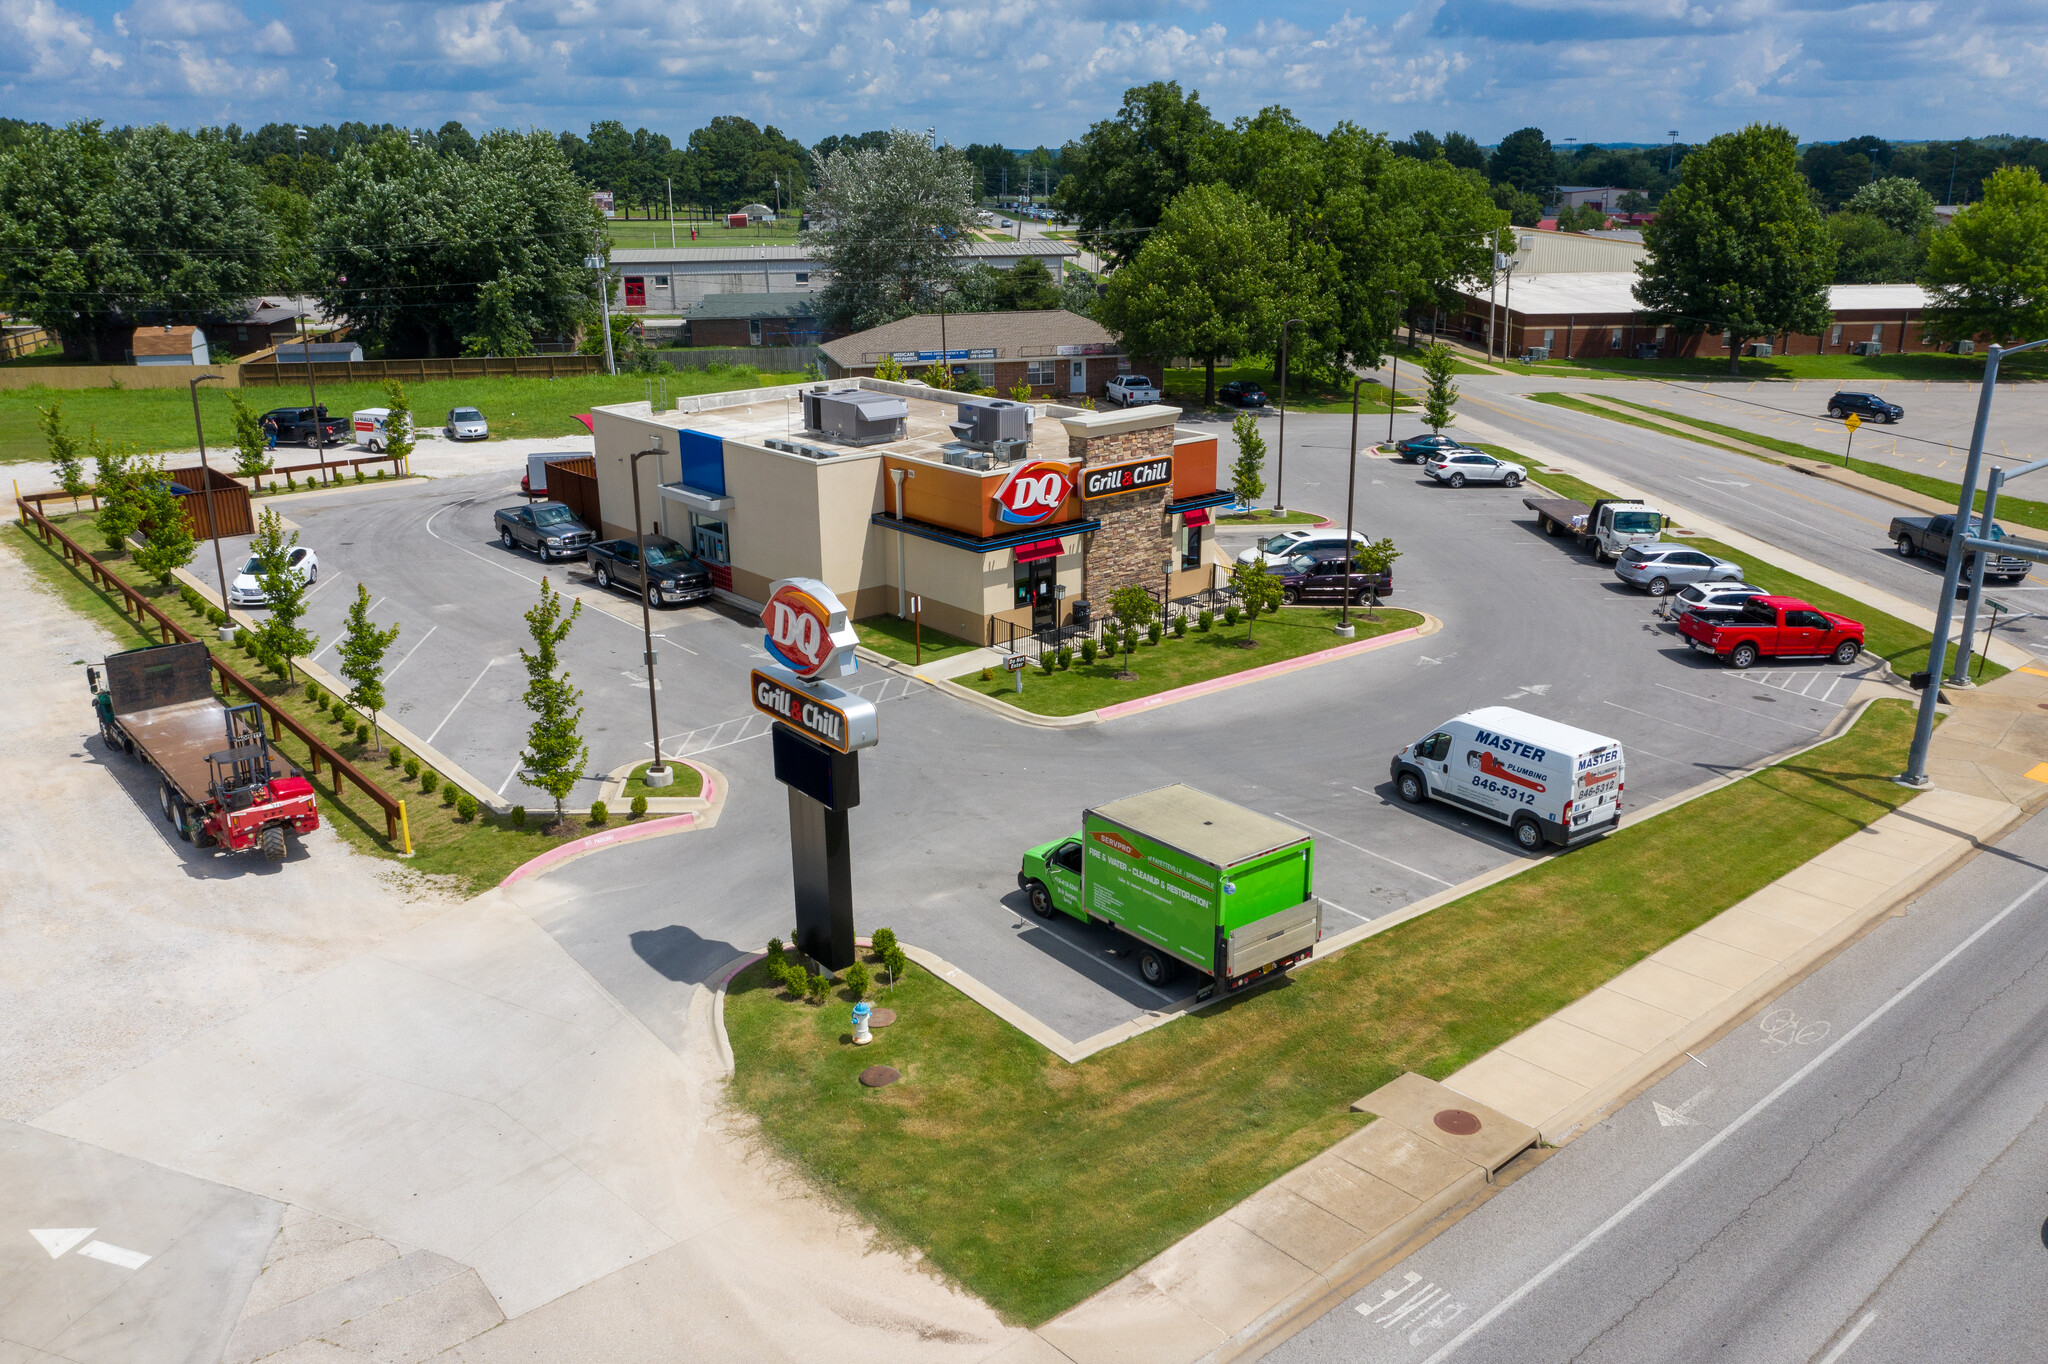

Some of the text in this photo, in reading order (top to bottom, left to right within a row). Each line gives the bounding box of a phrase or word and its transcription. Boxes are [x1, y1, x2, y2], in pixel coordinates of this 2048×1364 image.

[1012, 473, 1062, 510] DQ
[1089, 473, 1122, 493] Grill
[1133, 462, 1167, 484] Chill
[772, 601, 822, 665] DQ
[758, 682, 791, 717] Grill
[803, 703, 840, 741] Chill
[1474, 730, 1546, 763] MASTER
[1578, 750, 1618, 771] MASTER
[1507, 763, 1548, 782] PLUMBING
[1472, 775, 1535, 806] 846-5312
[1578, 780, 1615, 800] 846-5312
[1100, 834, 1132, 854] SERVPRO
[1089, 847, 1101, 859] FIRE
[1108, 856, 1128, 872] WATER
[1132, 867, 1160, 886] CLEANUP
[1166, 882, 1209, 909] RESTORATION
[1152, 856, 1182, 875] FAYETTEVILLE
[1355, 1270, 1467, 1348] BIKE
